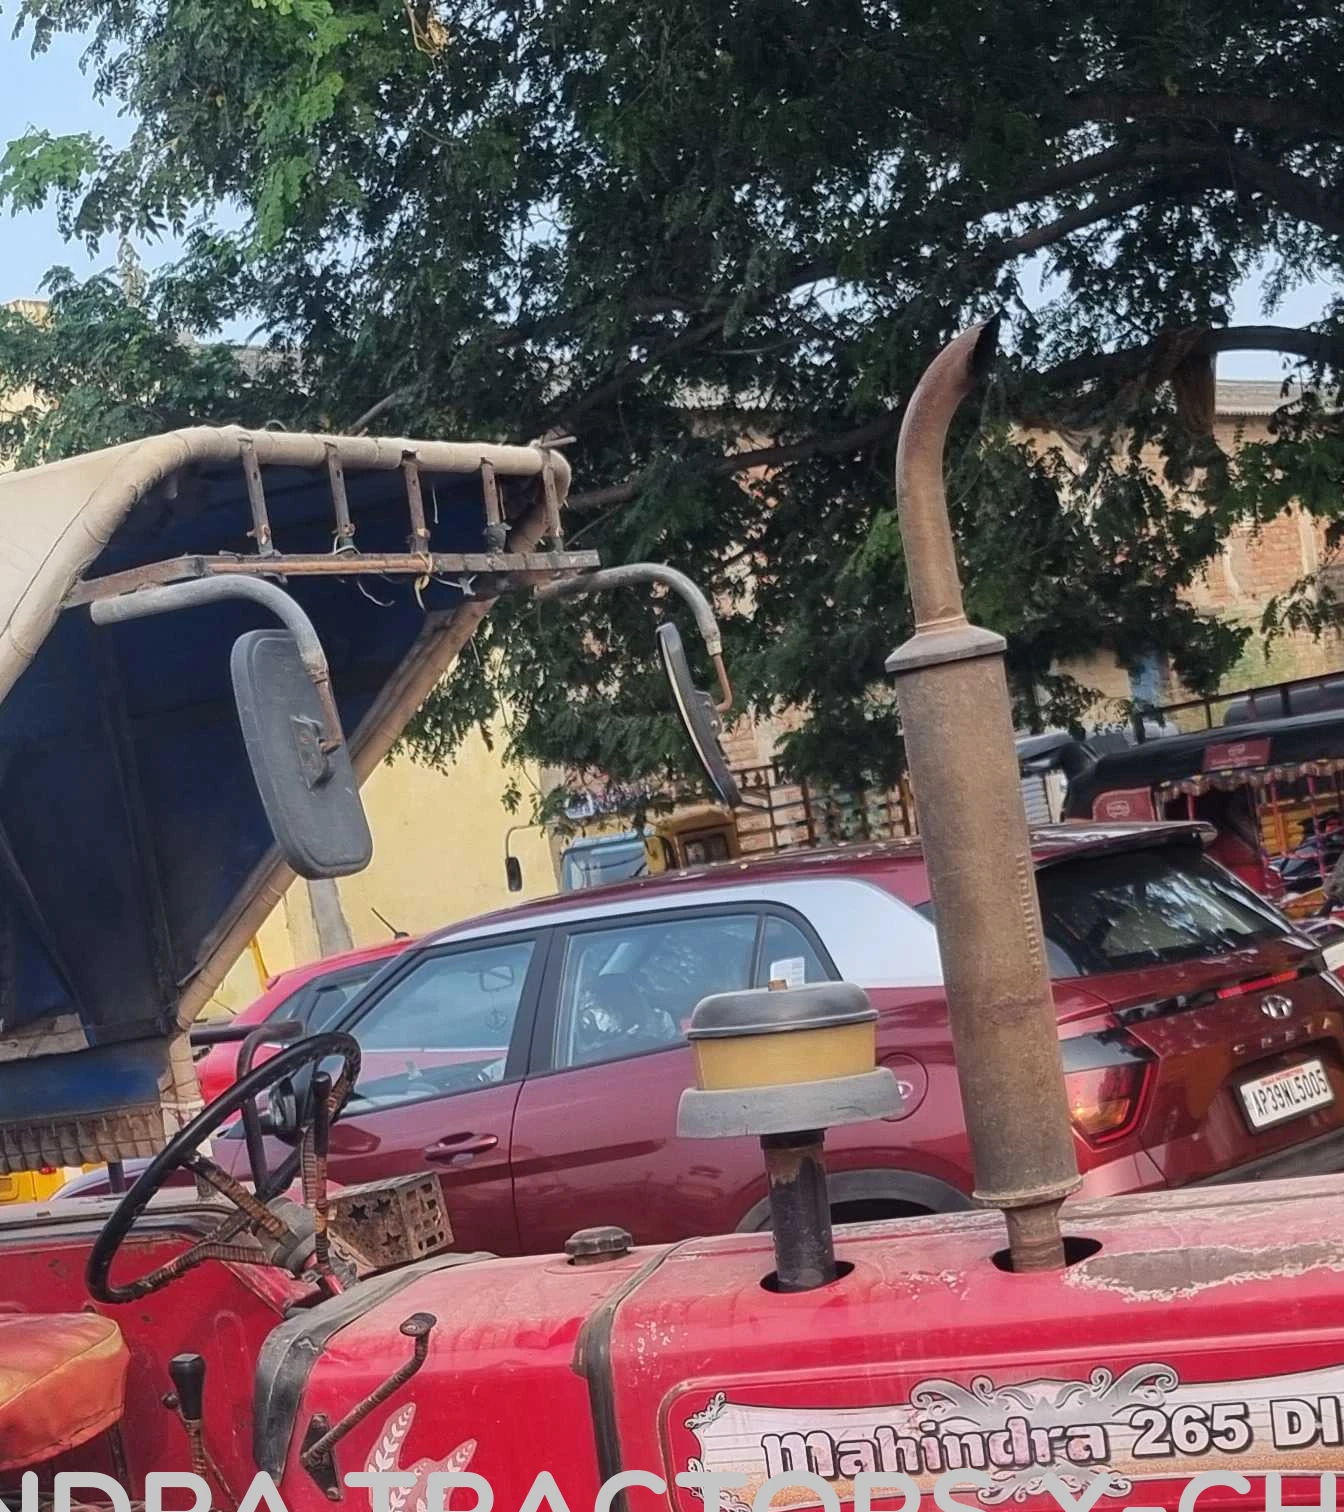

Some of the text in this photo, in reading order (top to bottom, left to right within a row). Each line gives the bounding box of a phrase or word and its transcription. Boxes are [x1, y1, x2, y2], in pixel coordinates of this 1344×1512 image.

[761, 1395, 1344, 1480] Mahindra 265 DI
